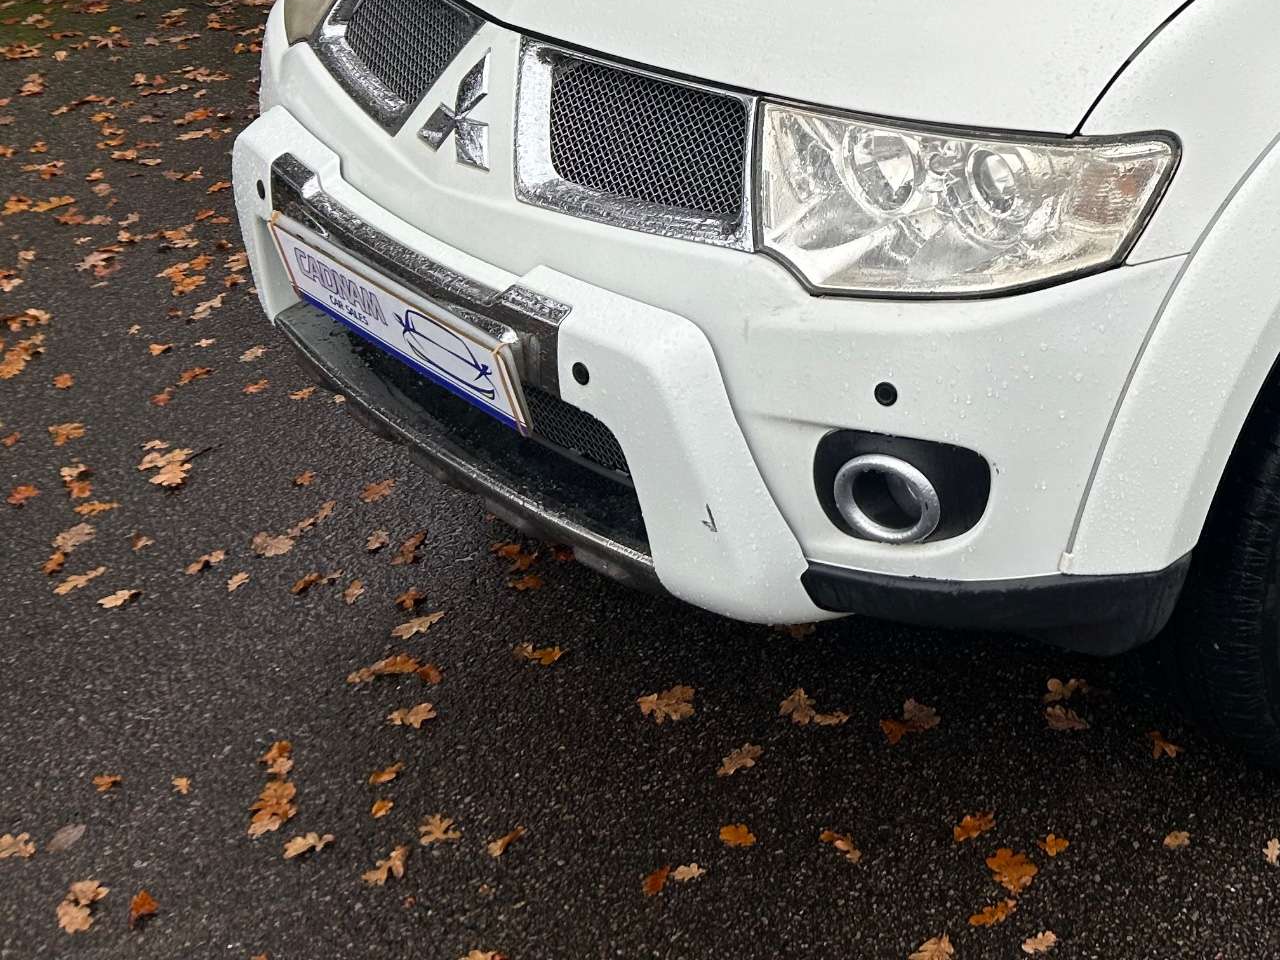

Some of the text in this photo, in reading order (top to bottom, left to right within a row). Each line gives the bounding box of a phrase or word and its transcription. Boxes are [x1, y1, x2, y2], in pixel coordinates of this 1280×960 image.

[294, 247, 389, 327] CADNAM
[329, 294, 369, 326] CAR SALES
